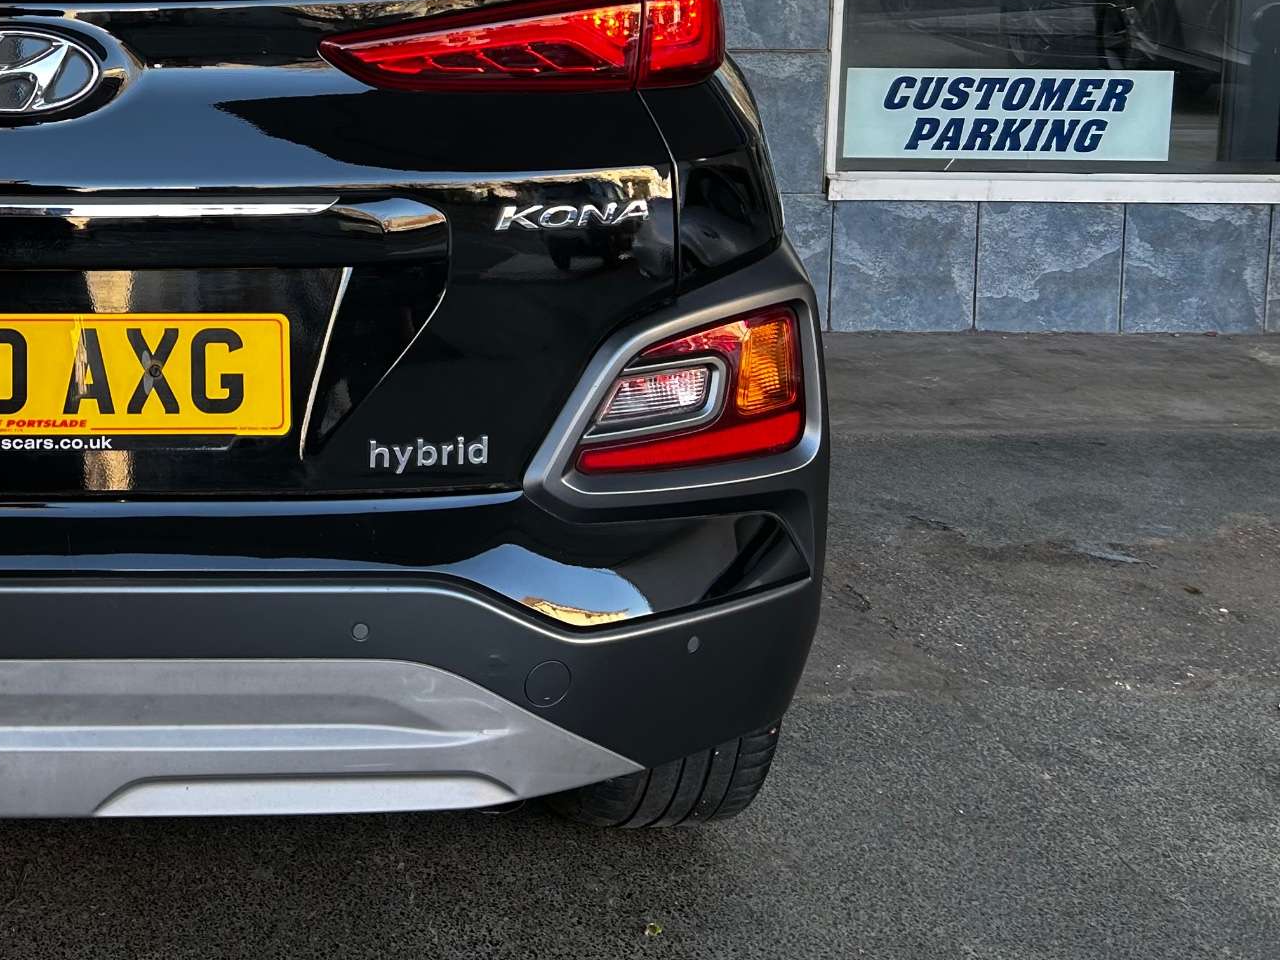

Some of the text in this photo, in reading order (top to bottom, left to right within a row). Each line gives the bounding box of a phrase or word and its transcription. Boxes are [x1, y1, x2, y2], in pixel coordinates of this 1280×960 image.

[883, 76, 1134, 112] CUSTOMER
[904, 118, 1108, 153] PARKING
[495, 199, 651, 232] KONA
[64, 328, 244, 415] AXG
[6, 419, 87, 428] PORTSLADE
[369, 434, 489, 474] hybrid
